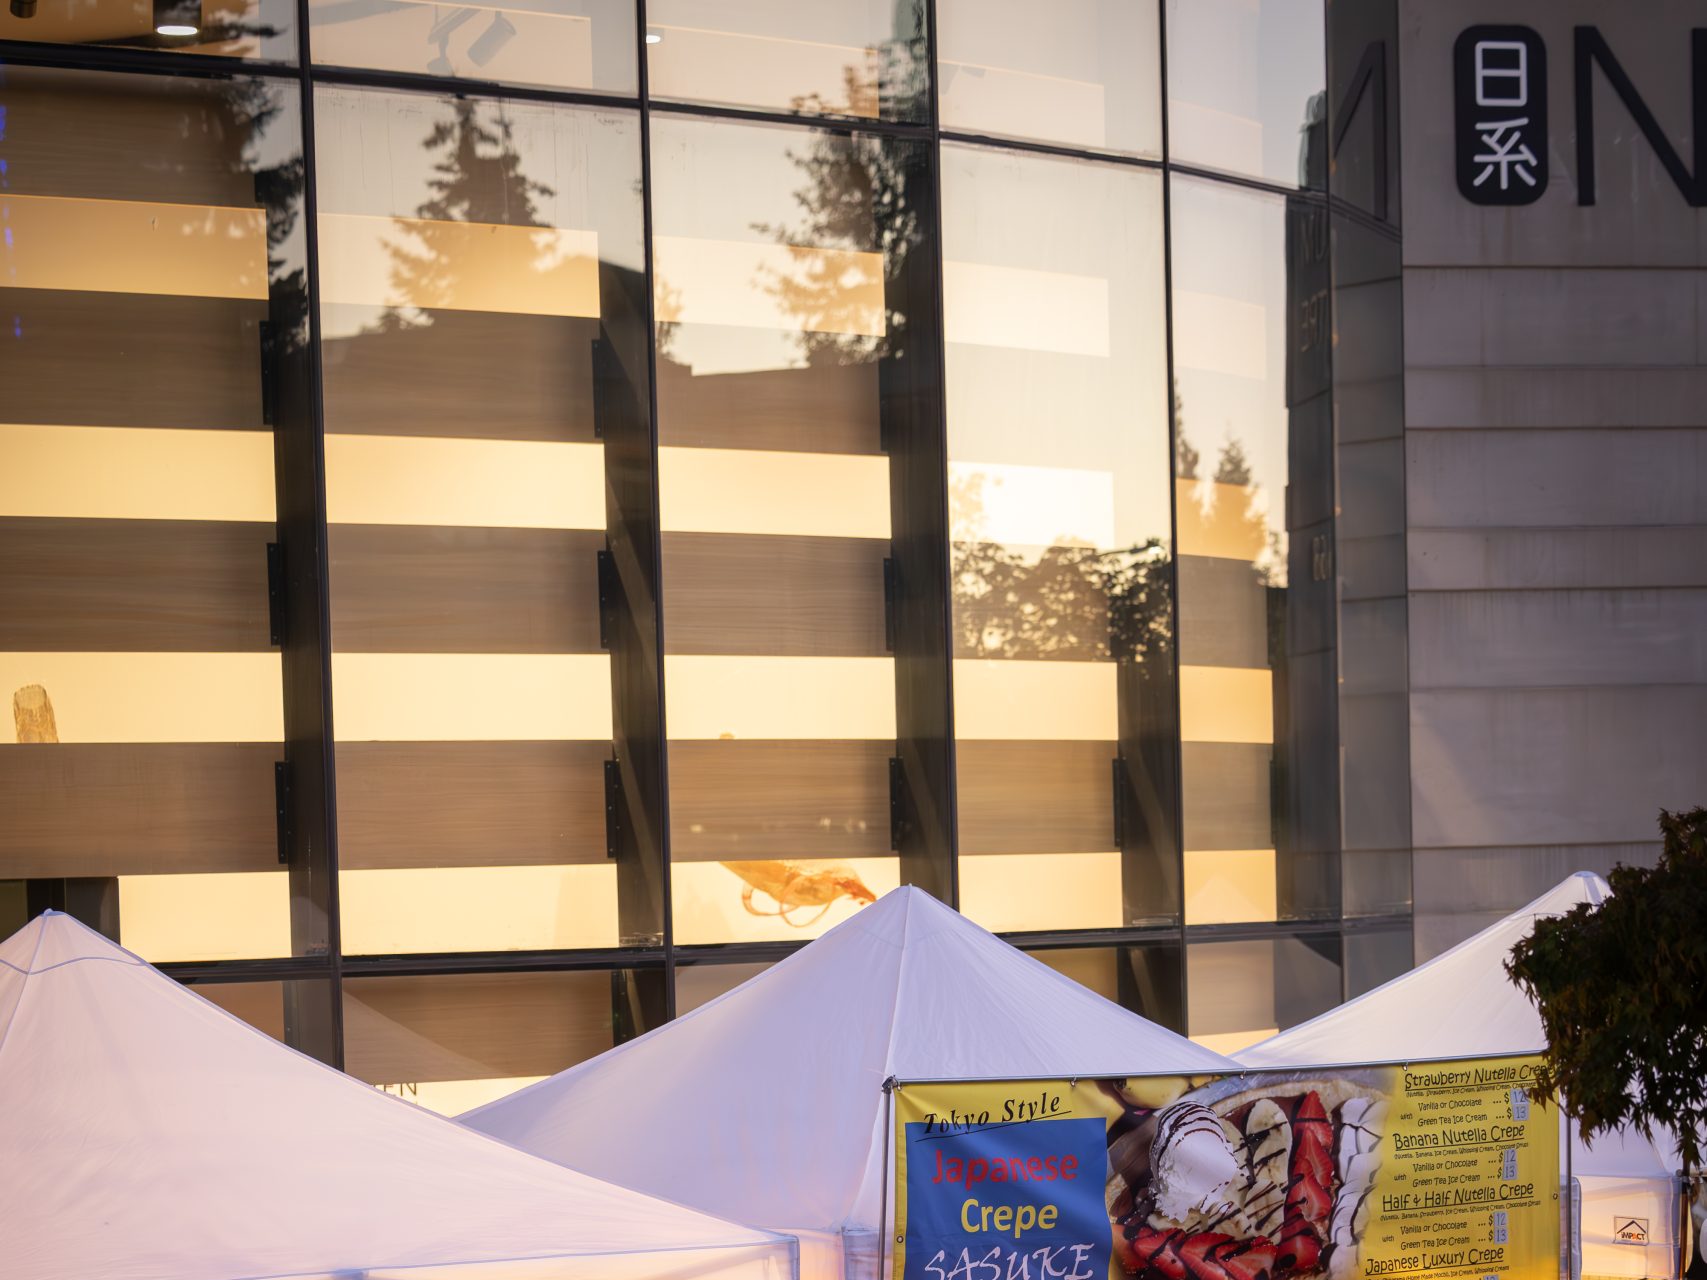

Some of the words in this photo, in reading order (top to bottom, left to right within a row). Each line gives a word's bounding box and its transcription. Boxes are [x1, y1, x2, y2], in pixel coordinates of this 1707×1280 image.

[1473, 40, 1538, 191] 日系
[1404, 1071, 1471, 1089] Strawberry
[1474, 1066, 1516, 1084] Nutella
[923, 1109, 990, 1135] Tokyo
[1001, 1092, 1061, 1123] Style
[1418, 1100, 1439, 1112] Vanilla
[1449, 1098, 1482, 1110] Chocolate
[1417, 1116, 1438, 1127] Green
[1438, 1116, 1452, 1125] Tea
[1452, 1115, 1464, 1124] Ice
[1465, 1113, 1488, 1123] Cream
[1392, 1132, 1439, 1149] Banana
[1442, 1127, 1488, 1145] Nutella
[1490, 1124, 1525, 1142] Crepe
[931, 1148, 1079, 1191] Japanese
[1413, 1161, 1435, 1173] Vanilla
[1436, 1162, 1444, 1170] or
[1444, 1159, 1478, 1169] Chocolate
[1393, 1173, 1407, 1182] with
[1412, 1176, 1433, 1188] Green
[1433, 1175, 1447, 1185] Tea
[1447, 1174, 1459, 1184] Ice
[1459, 1173, 1481, 1183] Cream
[1382, 1193, 1409, 1211] Half
[1424, 1188, 1452, 1207] Half
[1453, 1185, 1496, 1205] Nutella
[1499, 1182, 1534, 1201] Crepe
[960, 1198, 1058, 1239] Crepe
[1400, 1223, 1422, 1235] Vanilla
[1423, 1224, 1431, 1232] or
[1432, 1220, 1468, 1232] Chocolate
[1382, 1235, 1395, 1243] with
[1400, 1240, 1421, 1251] Green
[1422, 1238, 1436, 1248] Tea
[1436, 1238, 1449, 1247] Ice
[1449, 1235, 1470, 1246] Cream
[1365, 1255, 1419, 1275] Japanese
[1422, 1250, 1465, 1269] Luxury
[1468, 1246, 1504, 1265] Crepe
